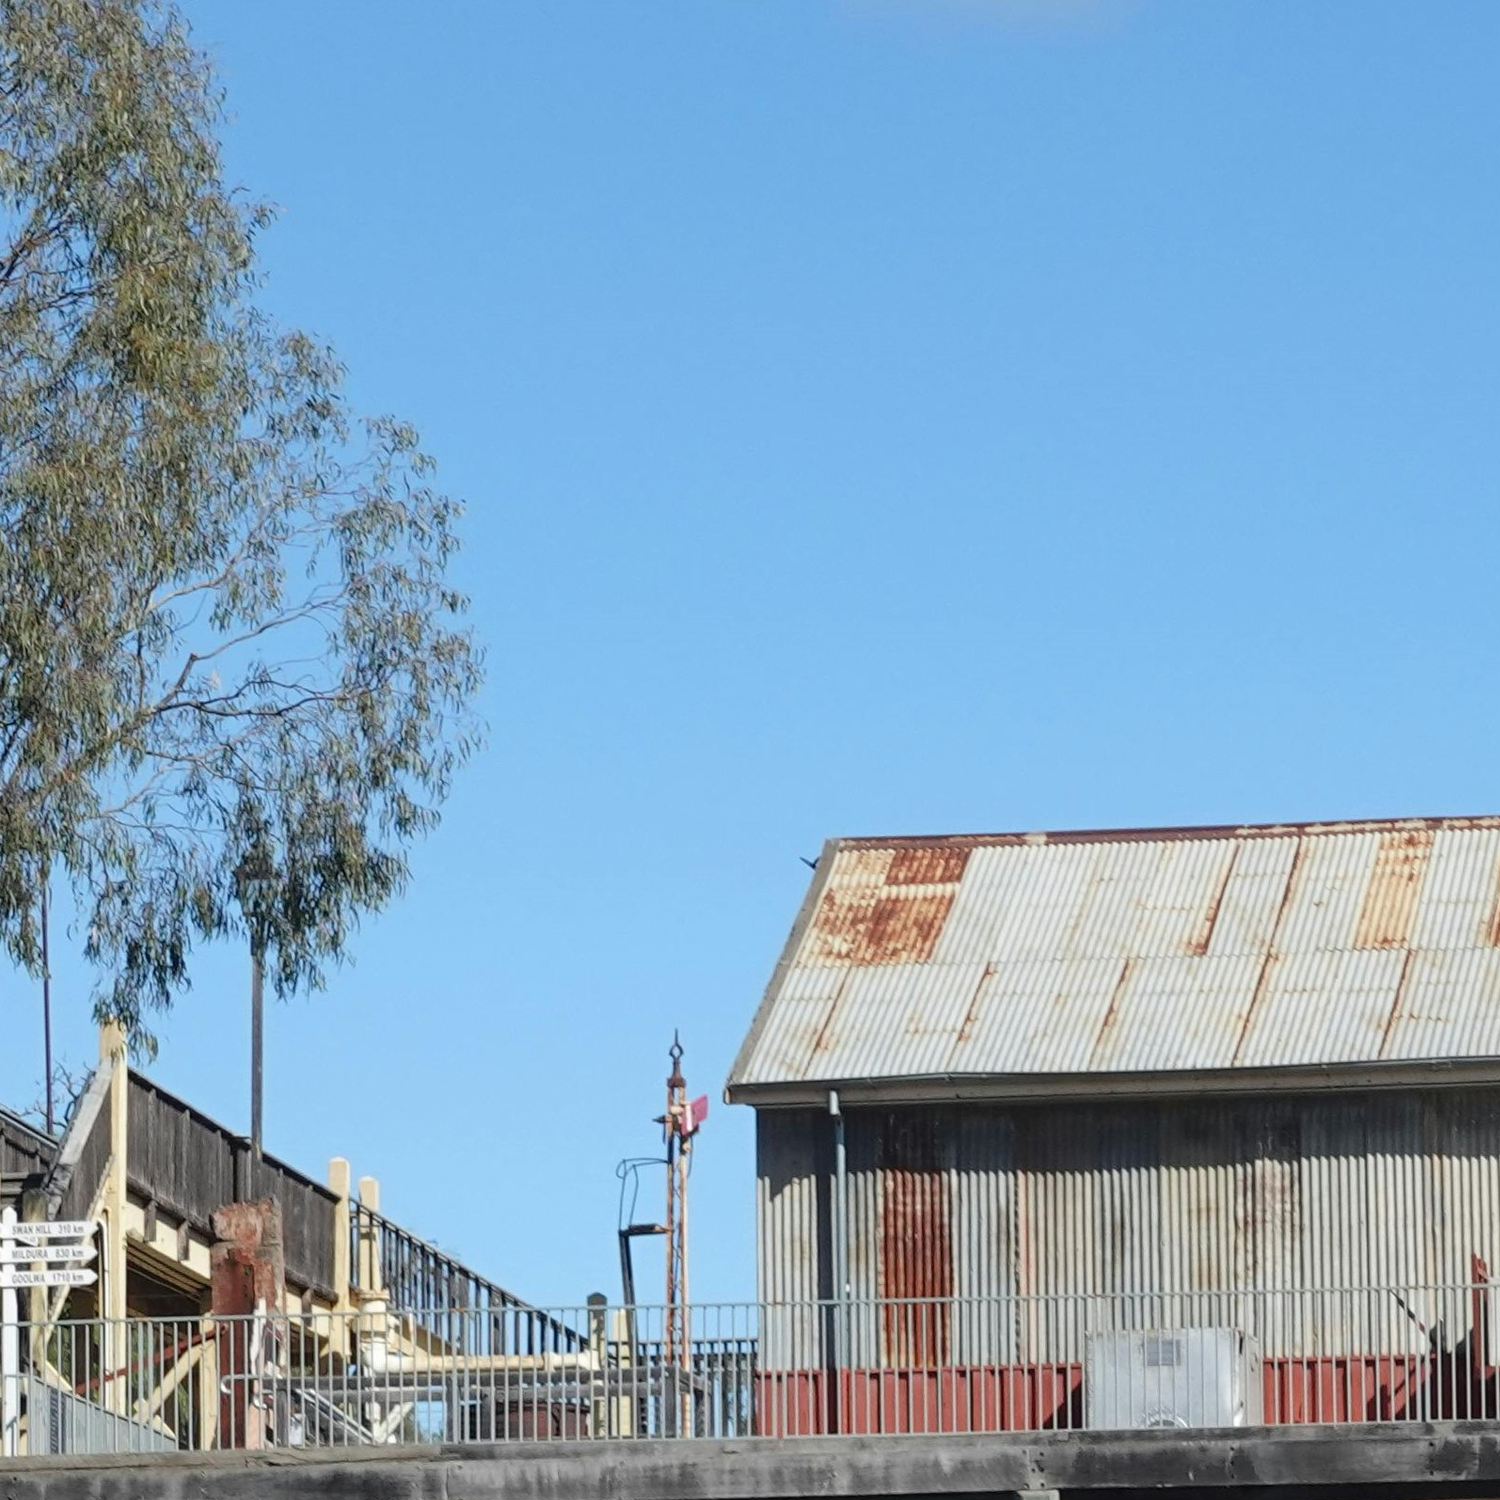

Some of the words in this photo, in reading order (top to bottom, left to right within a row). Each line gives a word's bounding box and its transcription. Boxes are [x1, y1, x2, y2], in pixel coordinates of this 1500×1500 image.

[12, 1225, 33, 1235] SWAN
[35, 1225, 51, 1234] HILL
[73, 1223, 84, 1233] km
[12, 1249, 48, 1259] MILDURA
[71, 1248, 84, 1258] km
[12, 1273, 46, 1284] GOOLWA
[72, 1272, 84, 1282] km
